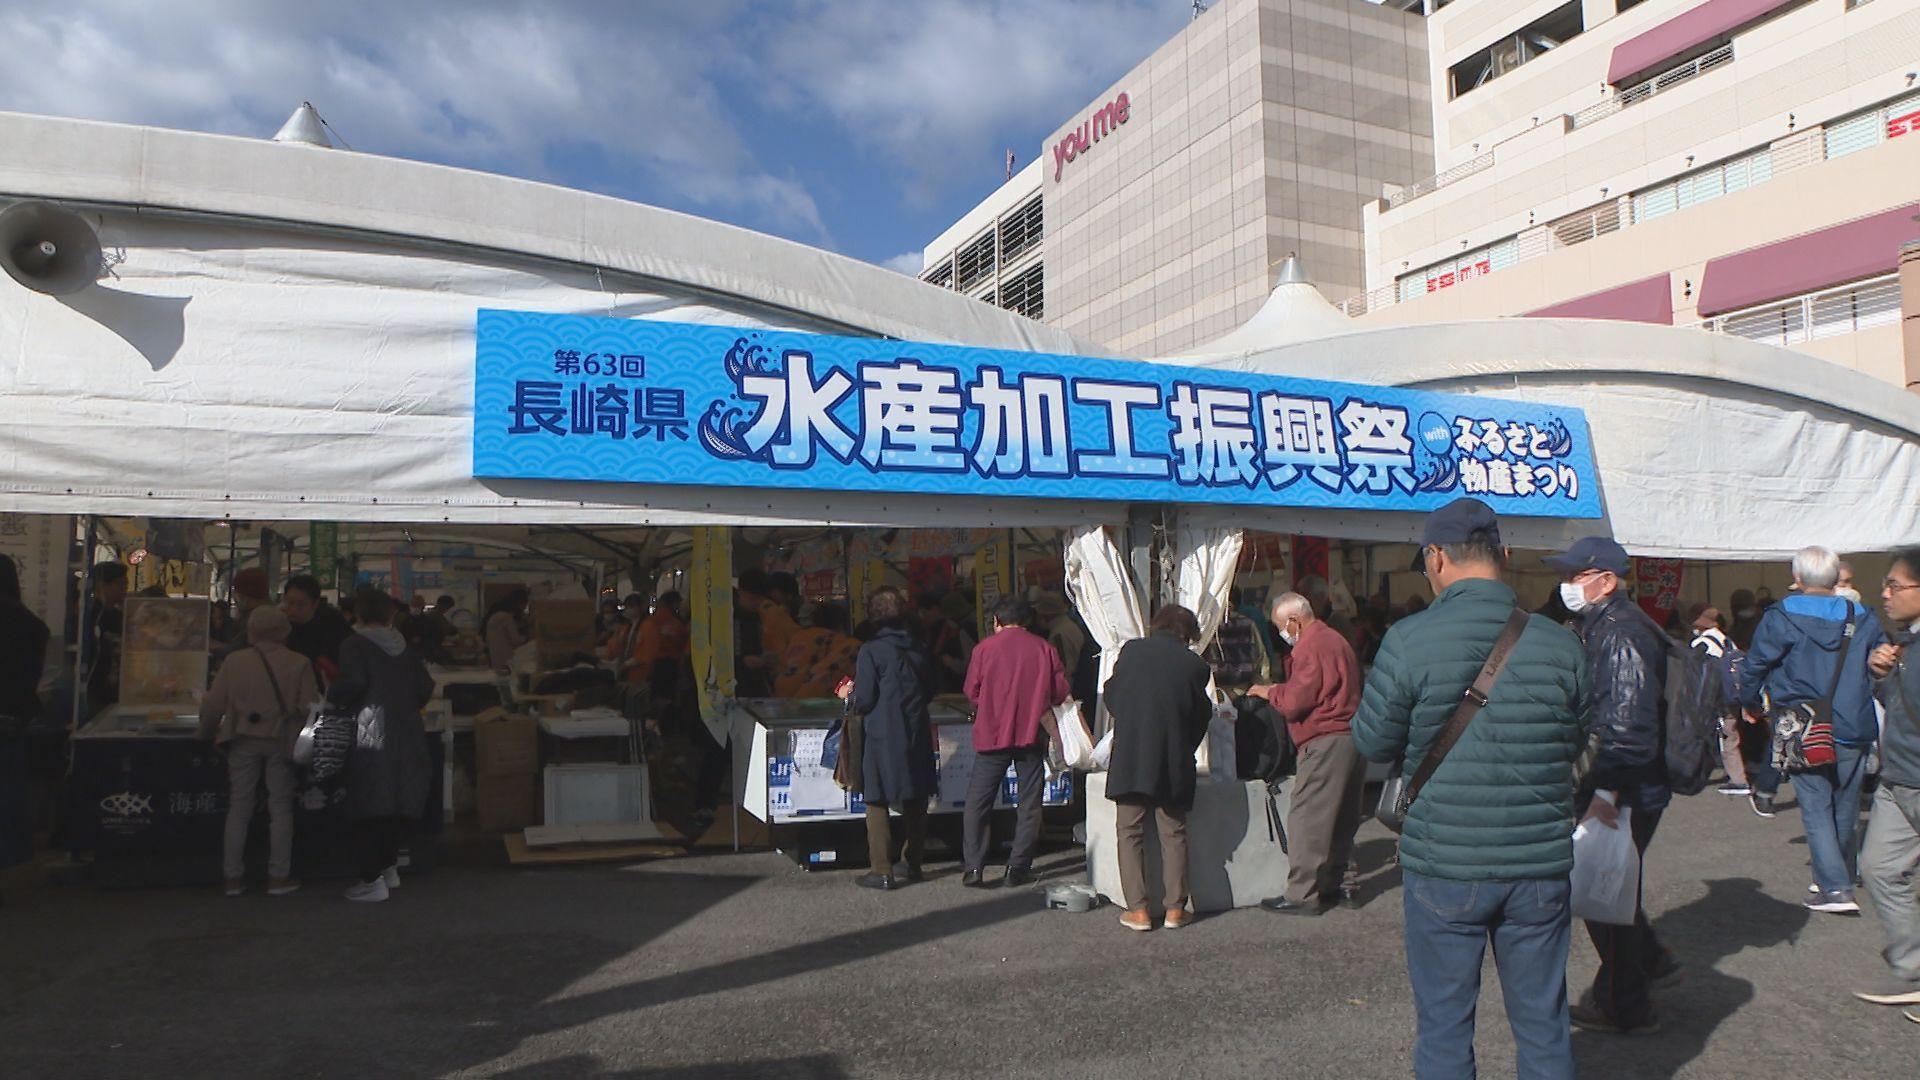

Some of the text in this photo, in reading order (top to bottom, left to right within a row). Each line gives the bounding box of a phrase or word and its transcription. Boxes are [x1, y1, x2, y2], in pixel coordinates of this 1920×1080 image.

[553, 350, 645, 378] 第63回
[508, 380, 690, 442] 長崎県
[741, 354, 1417, 492] 水産加工振興祭
[1424, 427, 1449, 442] with
[1454, 416, 1553, 460] ふるさと
[1458, 456, 1579, 500] 物産まつり
